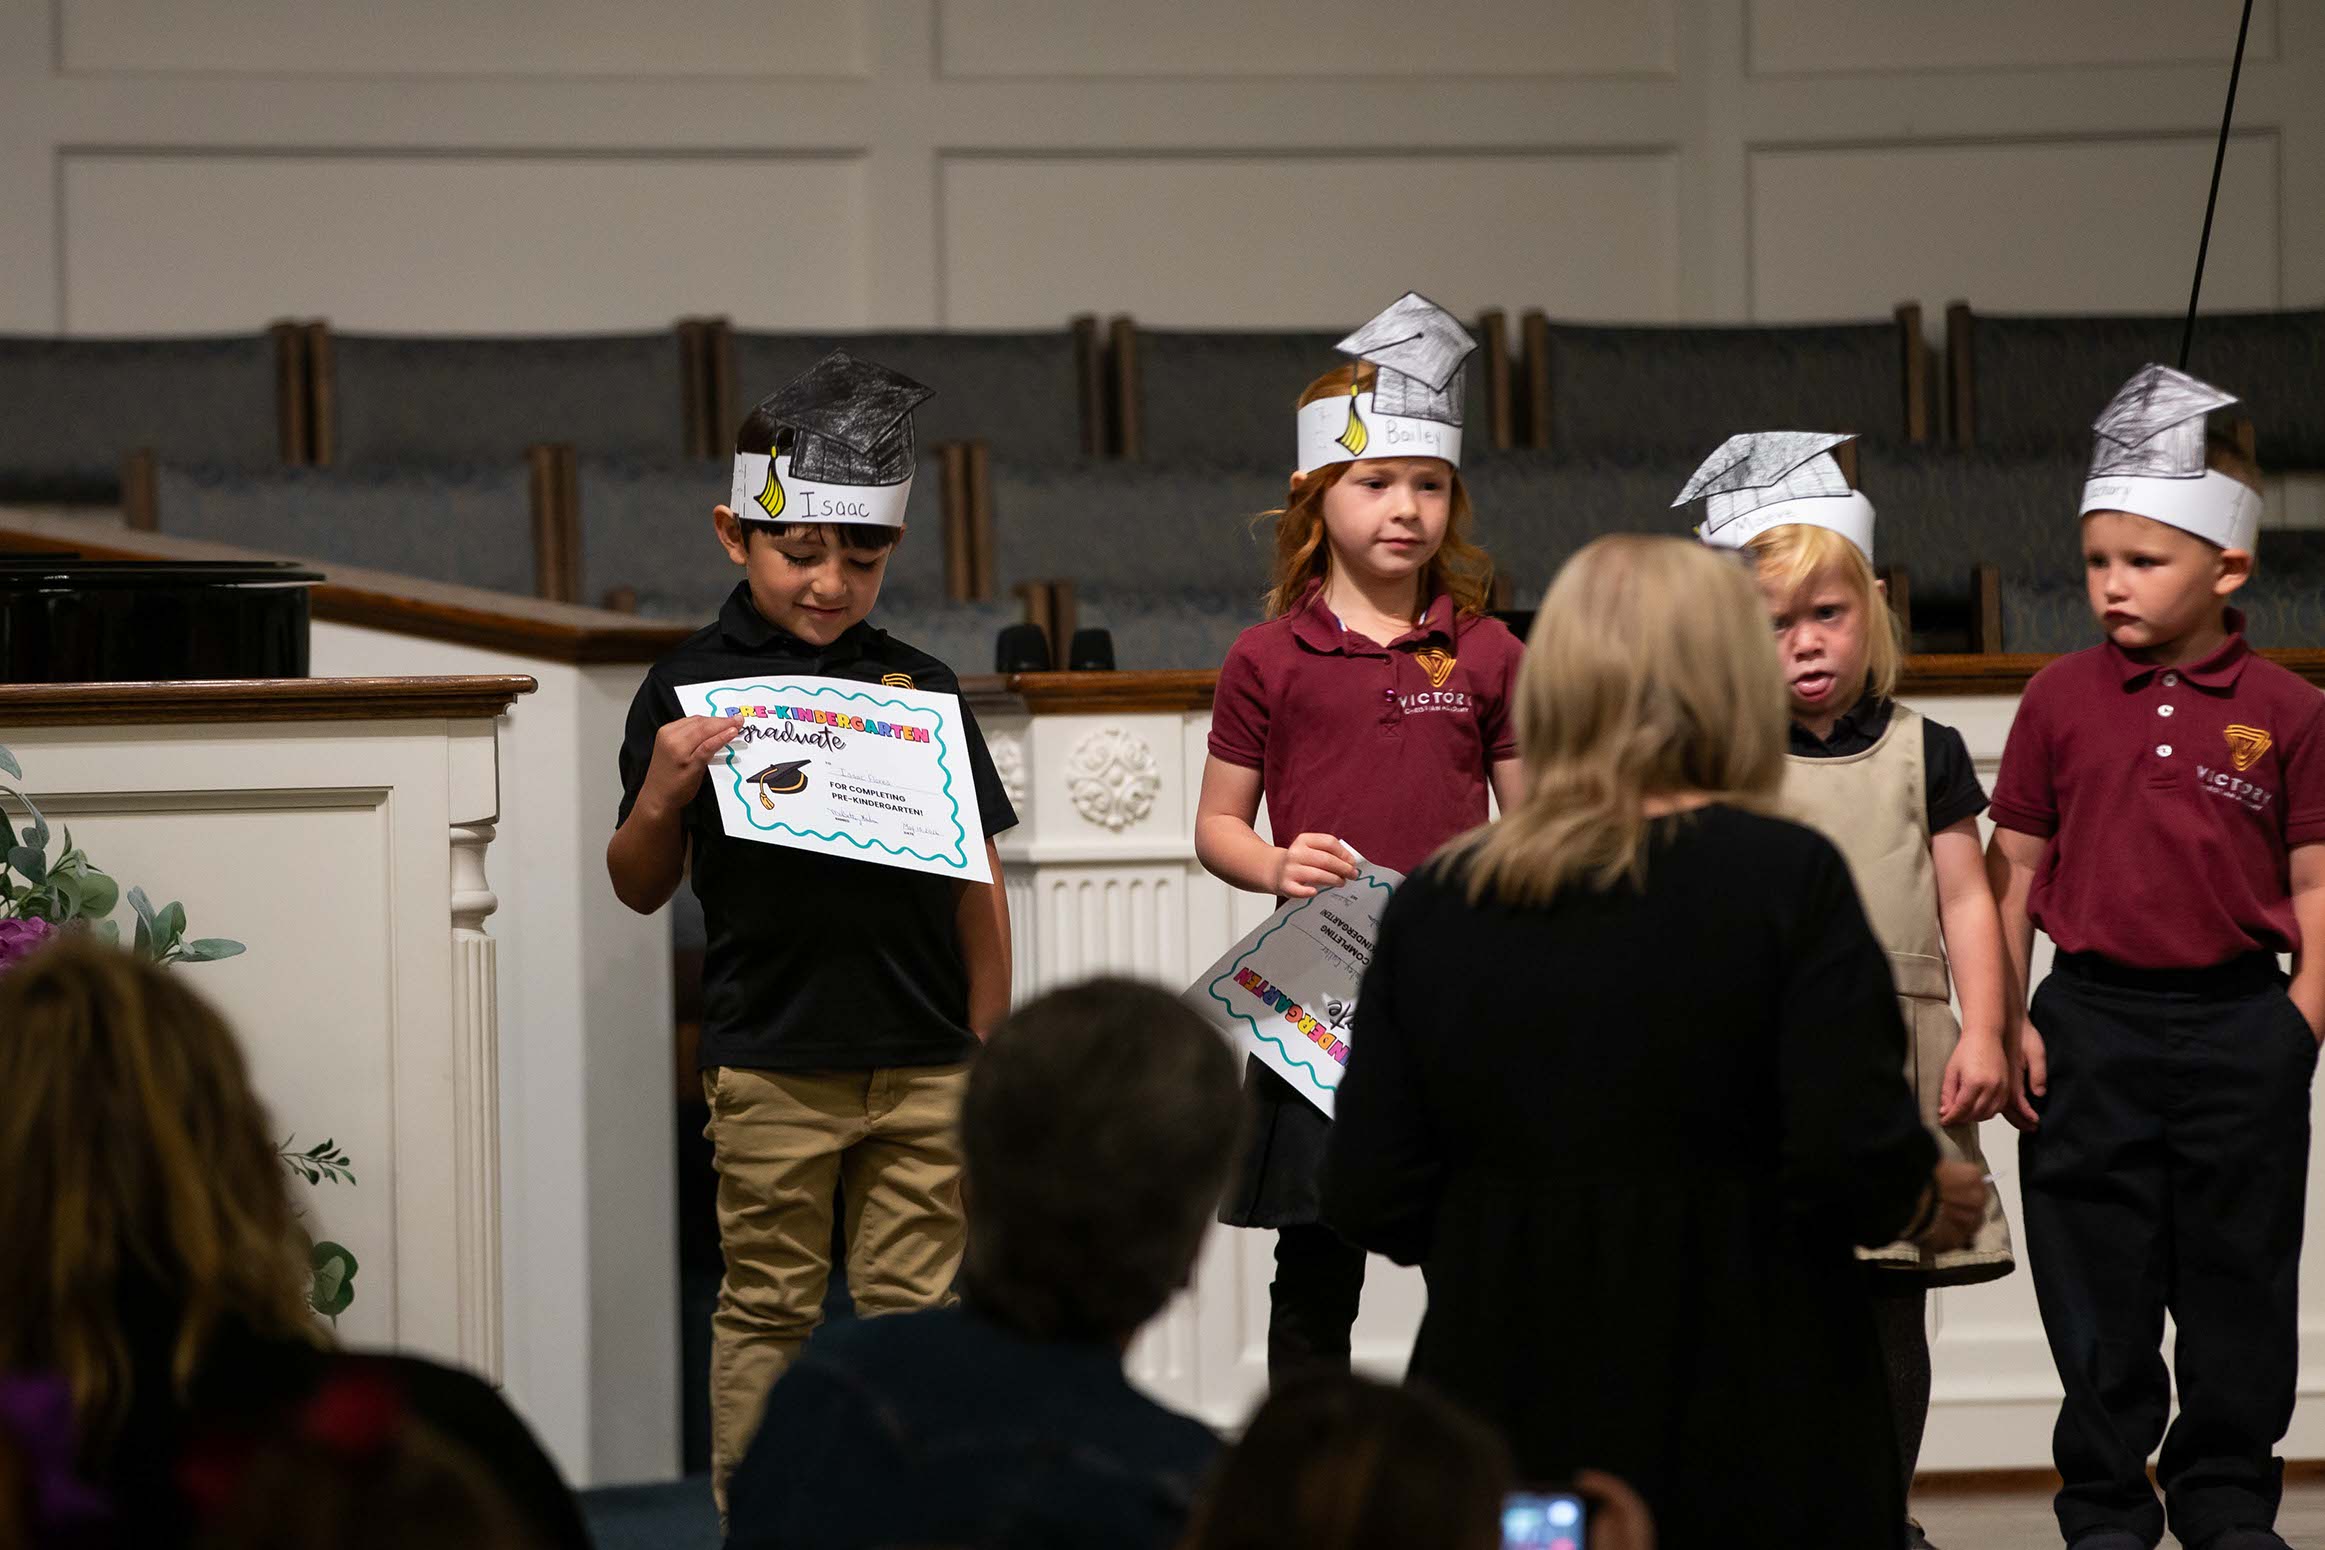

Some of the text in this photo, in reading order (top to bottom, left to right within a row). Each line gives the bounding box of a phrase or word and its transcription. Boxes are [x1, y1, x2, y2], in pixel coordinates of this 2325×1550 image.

[799, 491, 870, 518] Isaac
[725, 704, 930, 744] PRE-KINDERGARTEN
[738, 720, 847, 753] graduate
[829, 781, 906, 803] FOR COMPLETING
[831, 792, 924, 817] PRE-KINDERGARTEN!
[1320, 924, 1370, 966] COMPLETING
